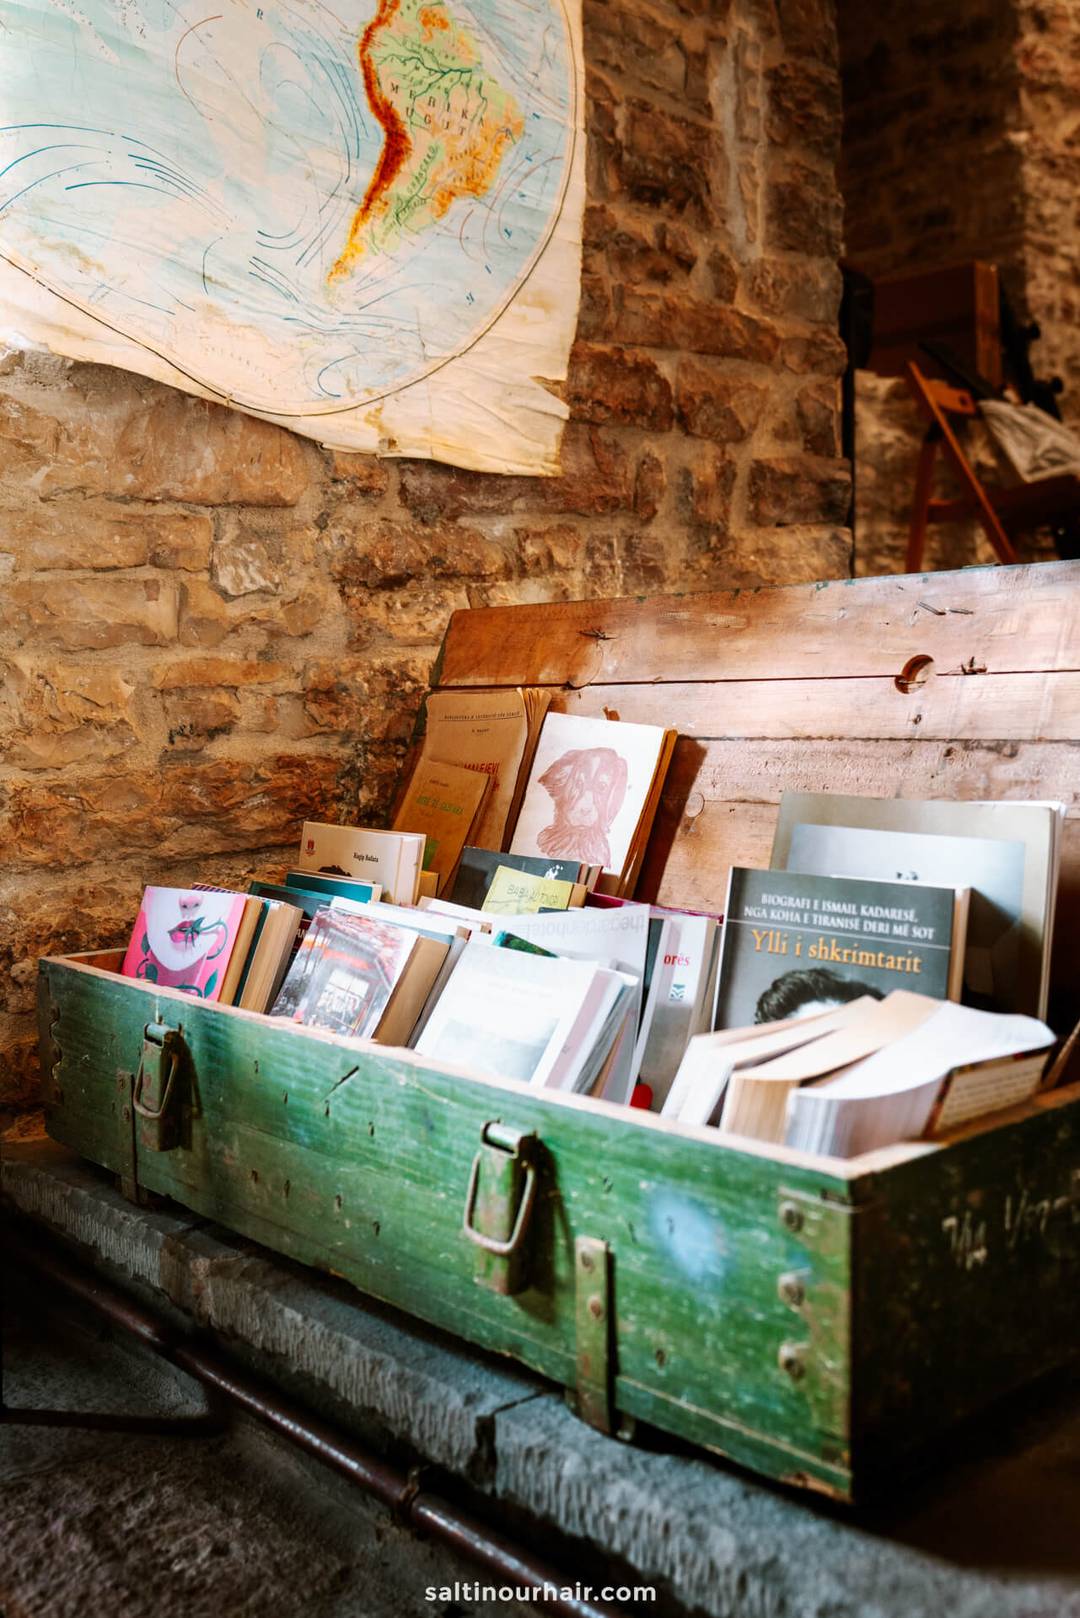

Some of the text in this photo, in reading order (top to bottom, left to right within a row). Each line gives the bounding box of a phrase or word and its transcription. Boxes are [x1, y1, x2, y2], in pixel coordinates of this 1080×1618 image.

[761, 893, 811, 910] BIOGRAFI
[813, 899, 820, 911] E
[822, 900, 858, 916] ISMAIL
[743, 905, 768, 919] NGA
[769, 909, 801, 923] KOHA
[803, 912, 811, 925] E
[863, 919, 891, 935] DERI
[911, 925, 935, 940] SOT
[752, 929, 923, 974] Ylli i shkrimtarit
